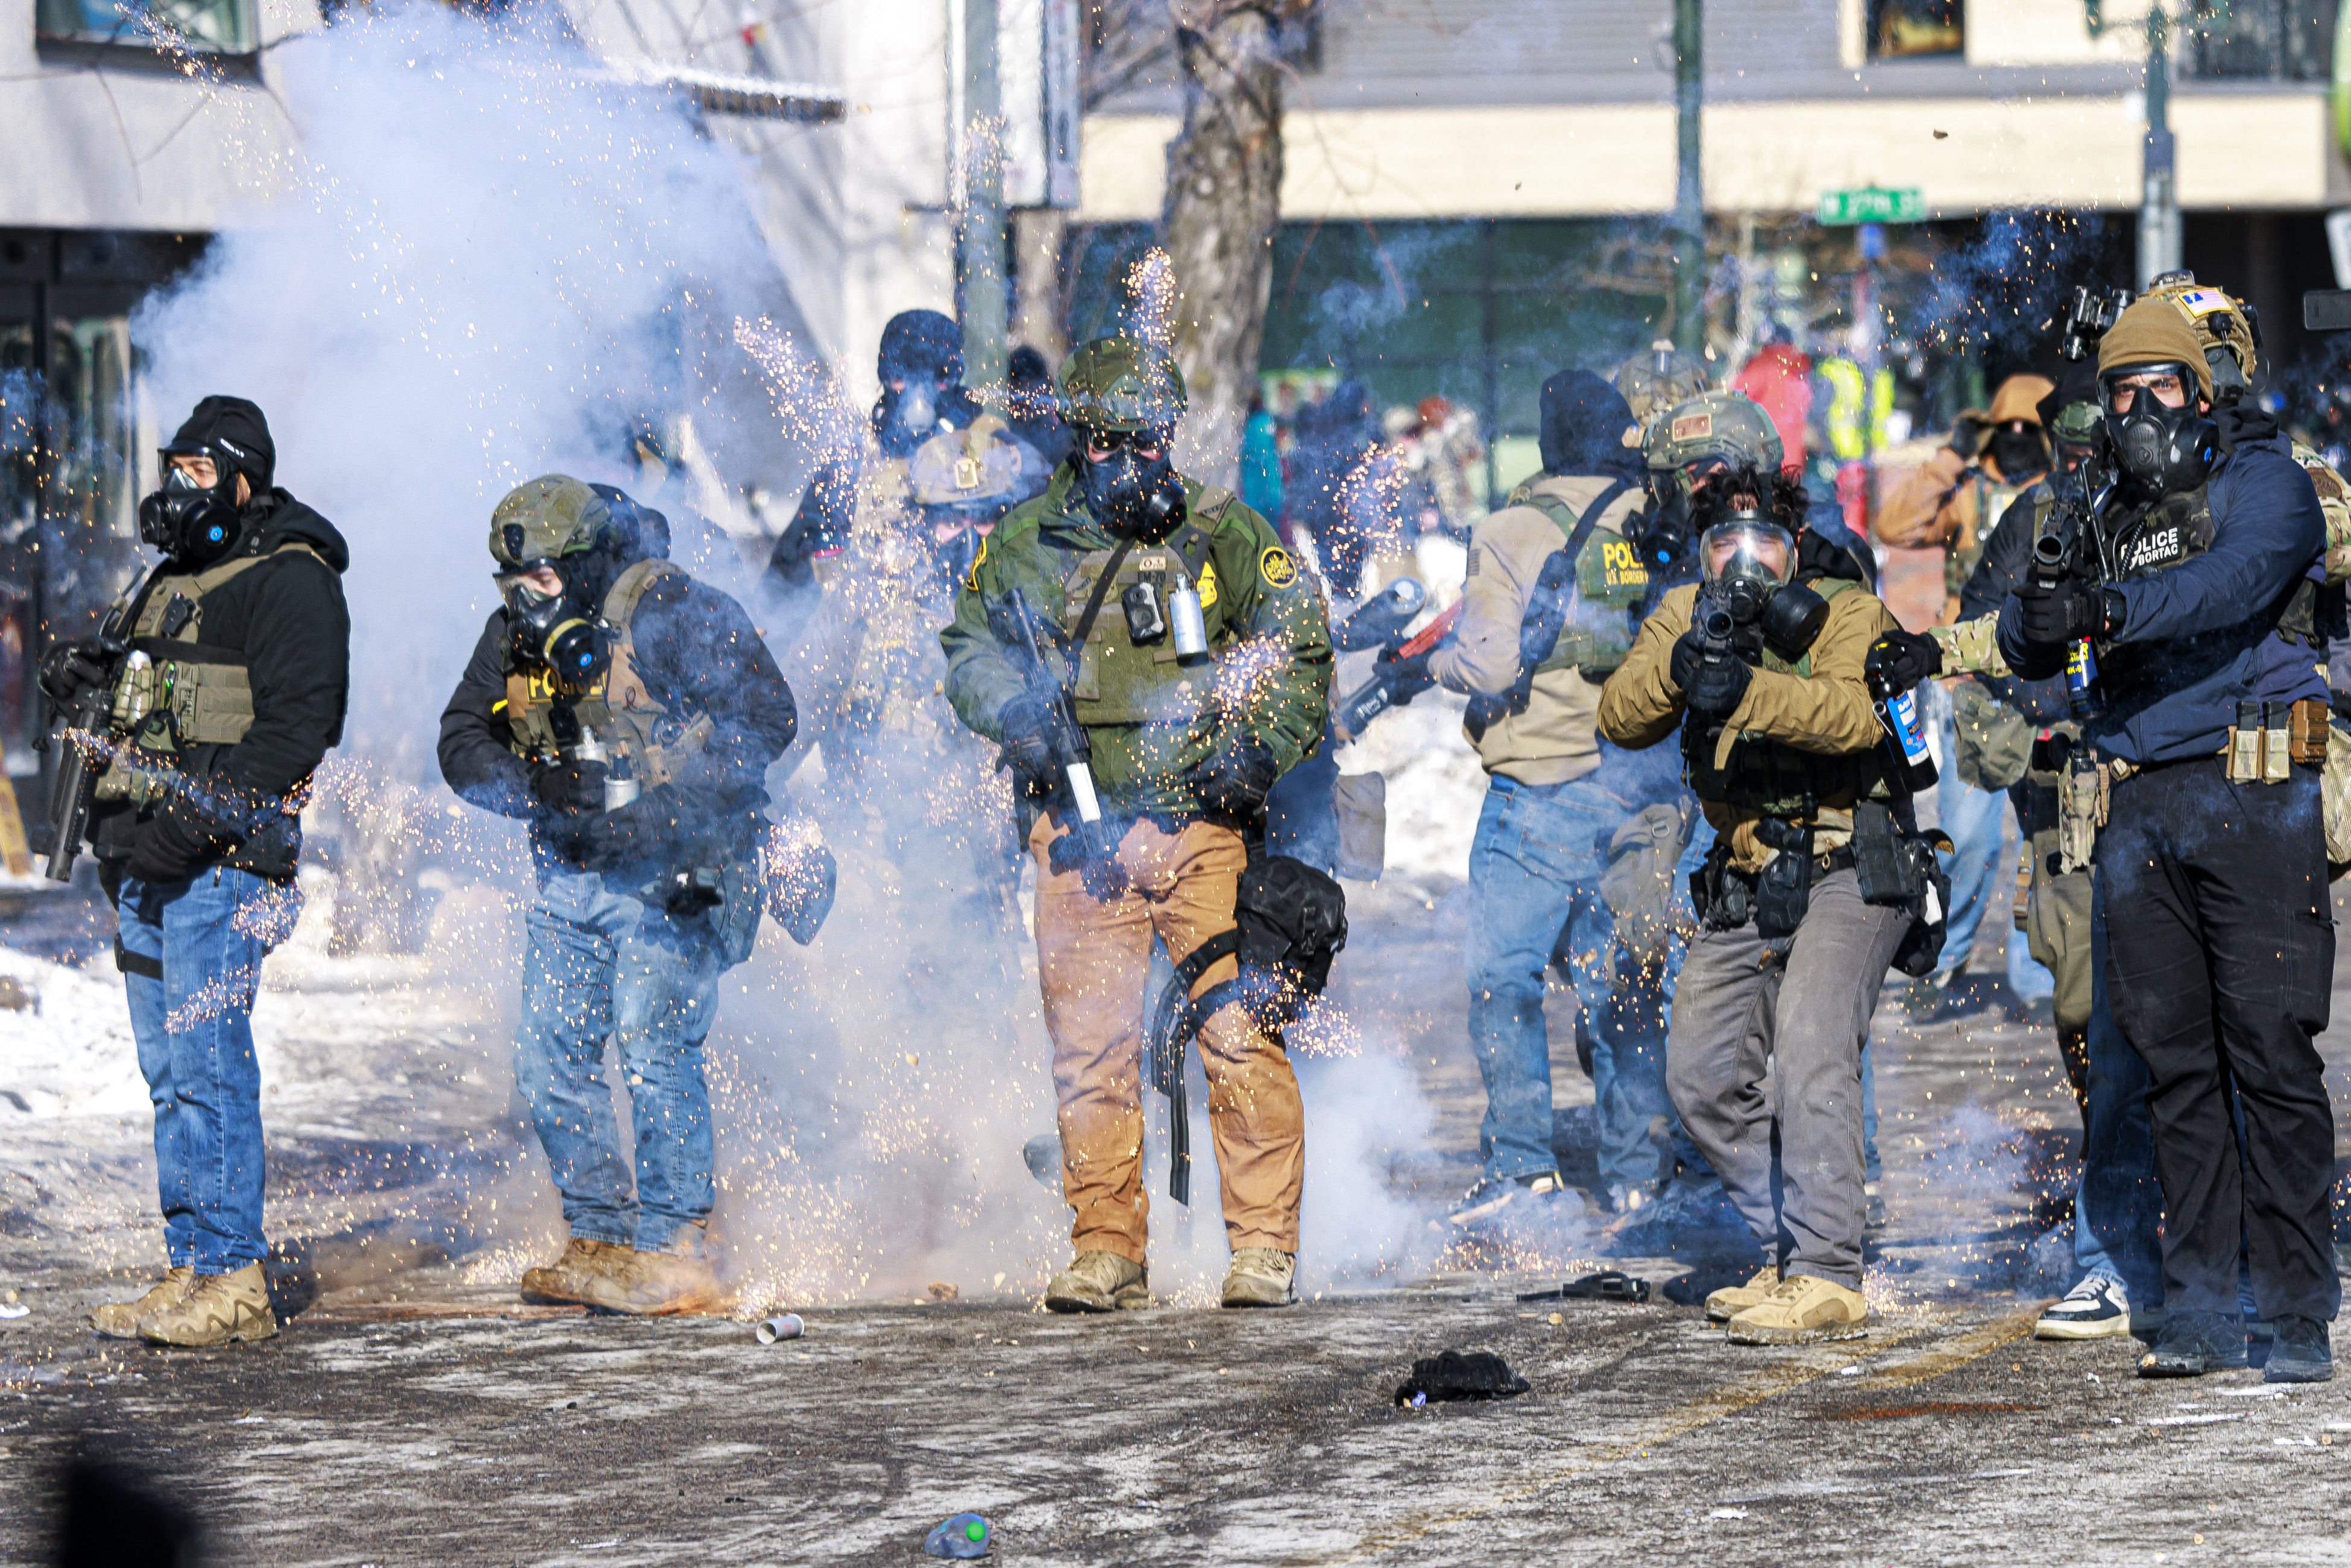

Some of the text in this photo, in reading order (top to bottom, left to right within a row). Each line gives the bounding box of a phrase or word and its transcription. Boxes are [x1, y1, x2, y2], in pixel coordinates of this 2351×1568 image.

[1602, 541, 1644, 570] POL
[2138, 543, 2178, 566] BORTAC
[1619, 570, 1645, 585] BORDER
